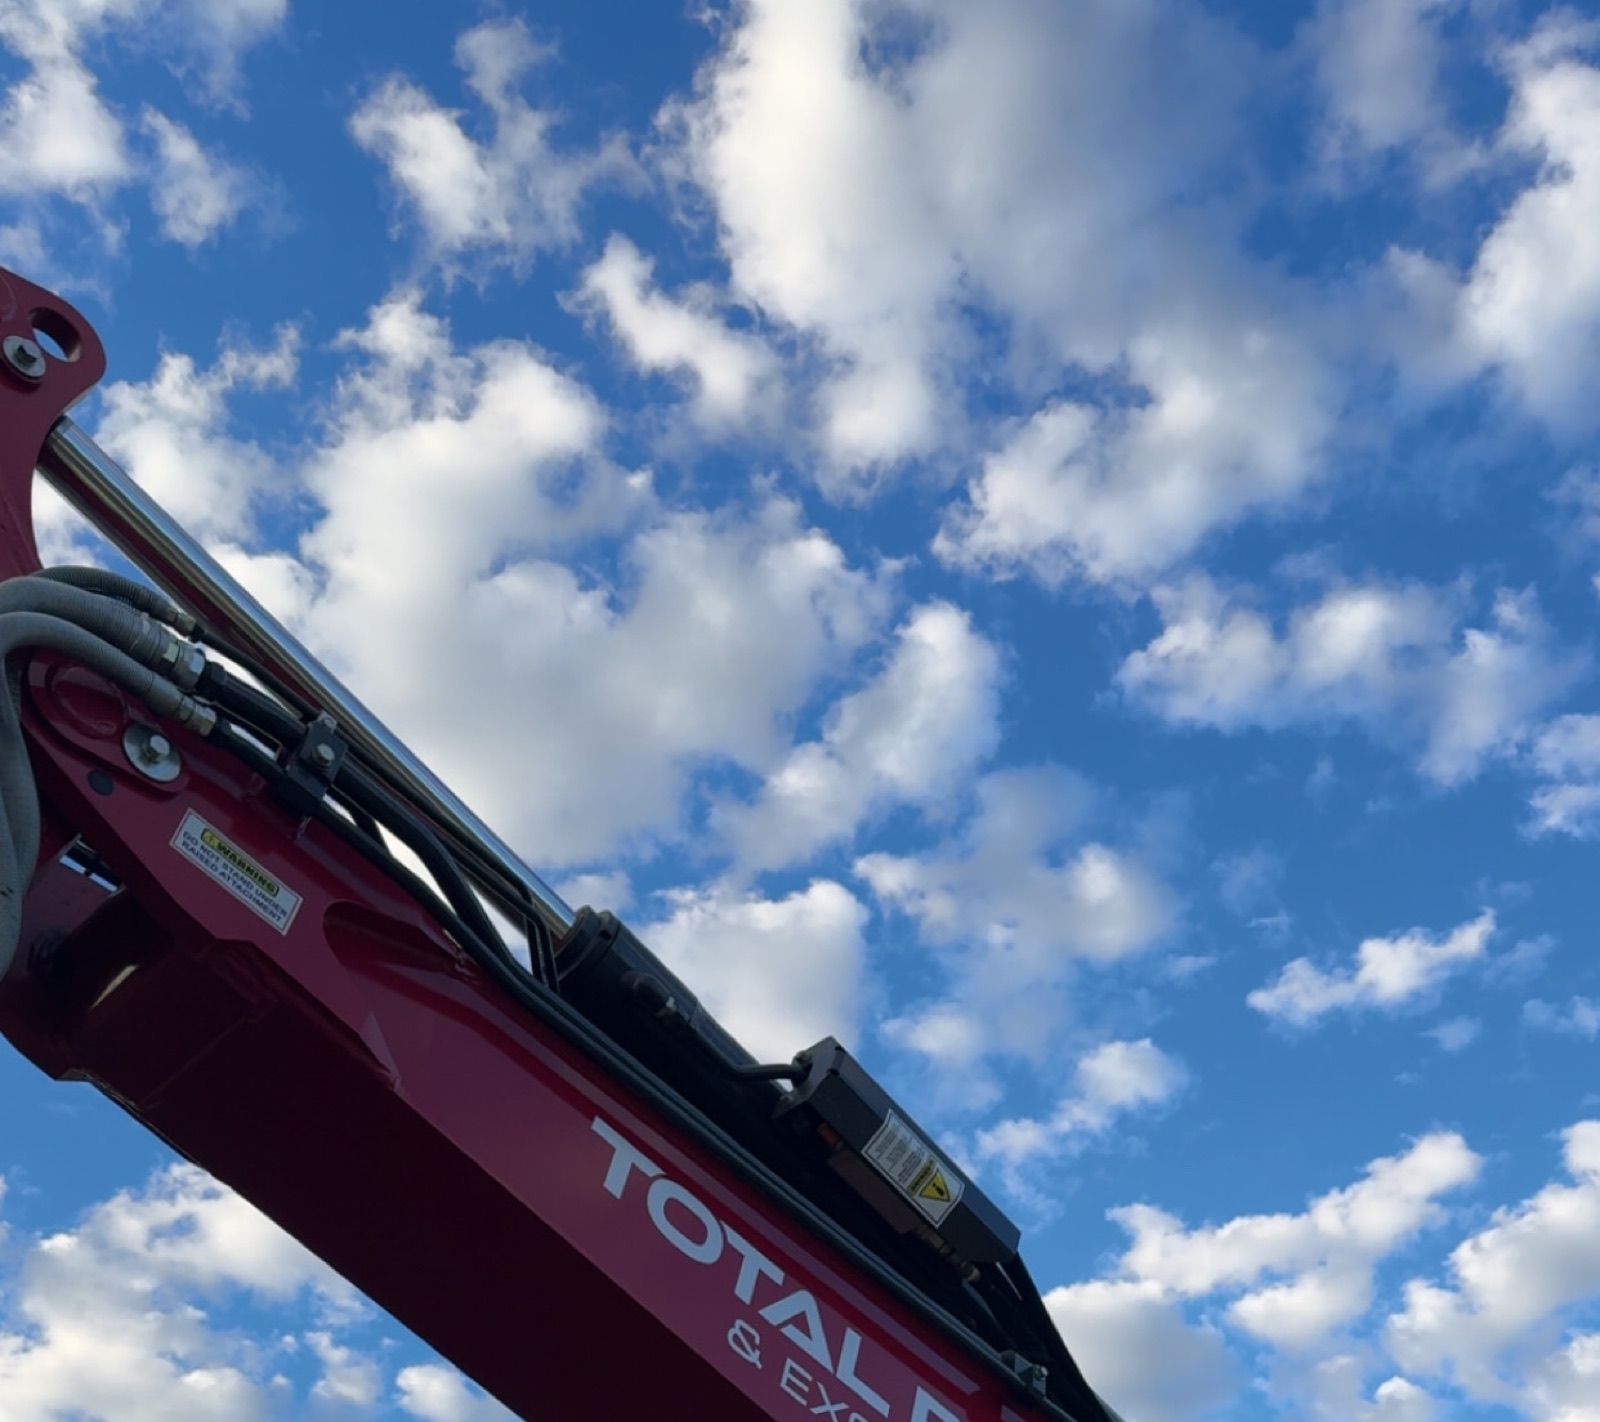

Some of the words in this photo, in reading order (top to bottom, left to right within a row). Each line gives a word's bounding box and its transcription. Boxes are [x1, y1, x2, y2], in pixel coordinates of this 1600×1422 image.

[180, 838, 219, 873] RAISED
[219, 871, 282, 921] ATTACHMENT
[181, 830, 199, 847] DO
[199, 843, 220, 864] NOT
[221, 861, 255, 891] STAND
[254, 887, 288, 918] UNDER
[216, 841, 277, 894] WARNING
[591, 1117, 890, 1418] TOTAL
[727, 1318, 763, 1369] &
